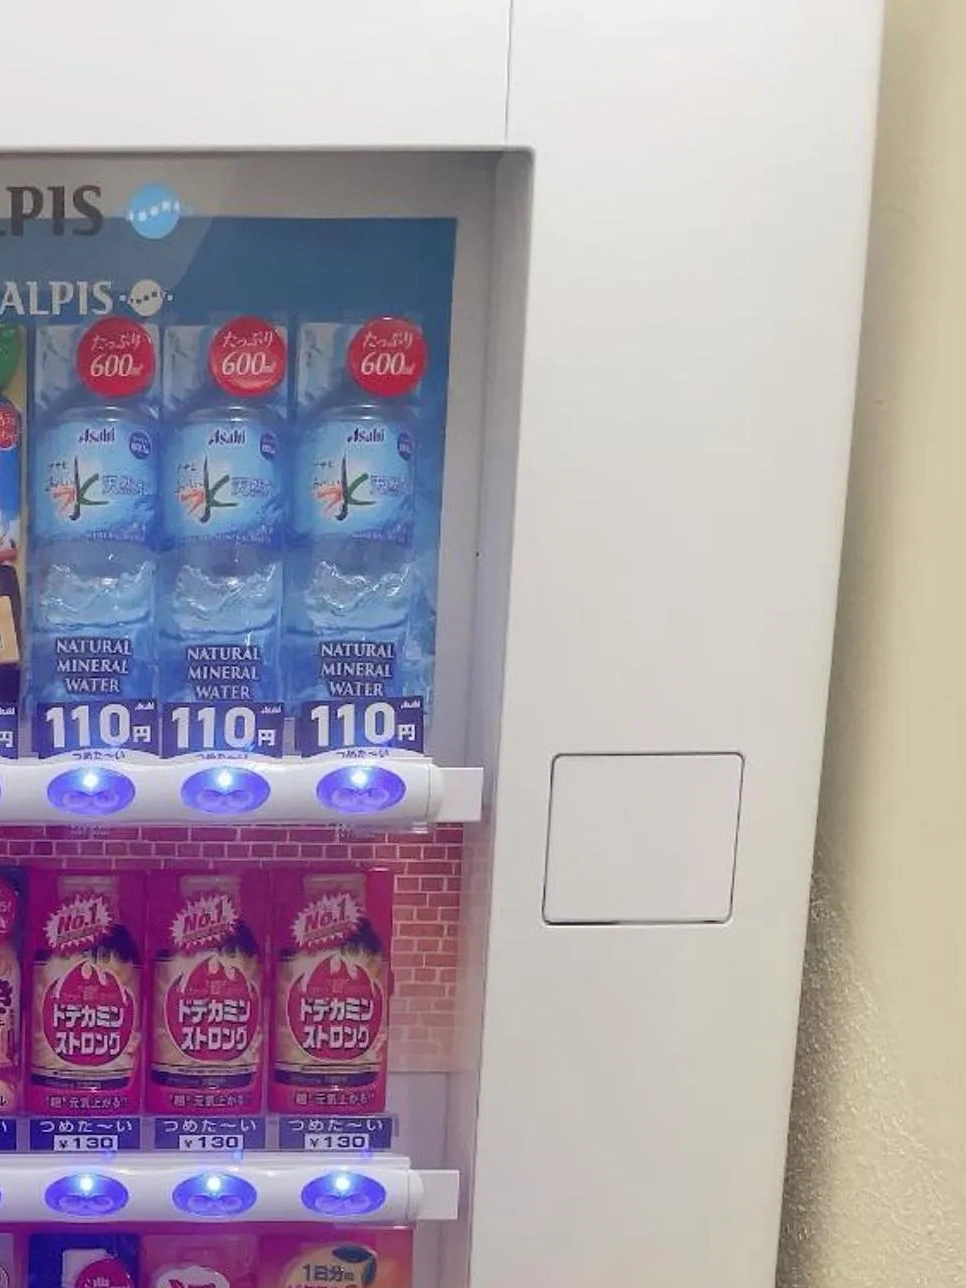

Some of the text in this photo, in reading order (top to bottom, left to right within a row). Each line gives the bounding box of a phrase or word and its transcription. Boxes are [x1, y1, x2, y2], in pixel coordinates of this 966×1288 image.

[92, 331, 141, 349] たっぷり
[222, 330, 274, 348] たっぷり
[362, 330, 413, 348] たっぷり
[78, 427, 115, 445] Asahi
[208, 427, 247, 446] Asahi
[346, 427, 385, 443] Asahi
[56, 638, 132, 655] NATURAL
[187, 645, 260, 661] NATURAL
[320, 642, 394, 659] NATURAL
[57, 658, 128, 674] MINERAL
[187, 664, 258, 680] MINERAL
[321, 662, 392, 678] MINERAL
[65, 678, 120, 693] WATER
[196, 685, 250, 699] WATER
[329, 681, 383, 696] WATER
[53, 1004, 124, 1027] ドデカミン
[179, 1000, 250, 1023] ドデカミン
[301, 1000, 374, 1021] ドデカミン
[56, 1032, 119, 1055] ストロング
[181, 1027, 247, 1050] ストロング
[303, 1025, 369, 1048] ストロング
